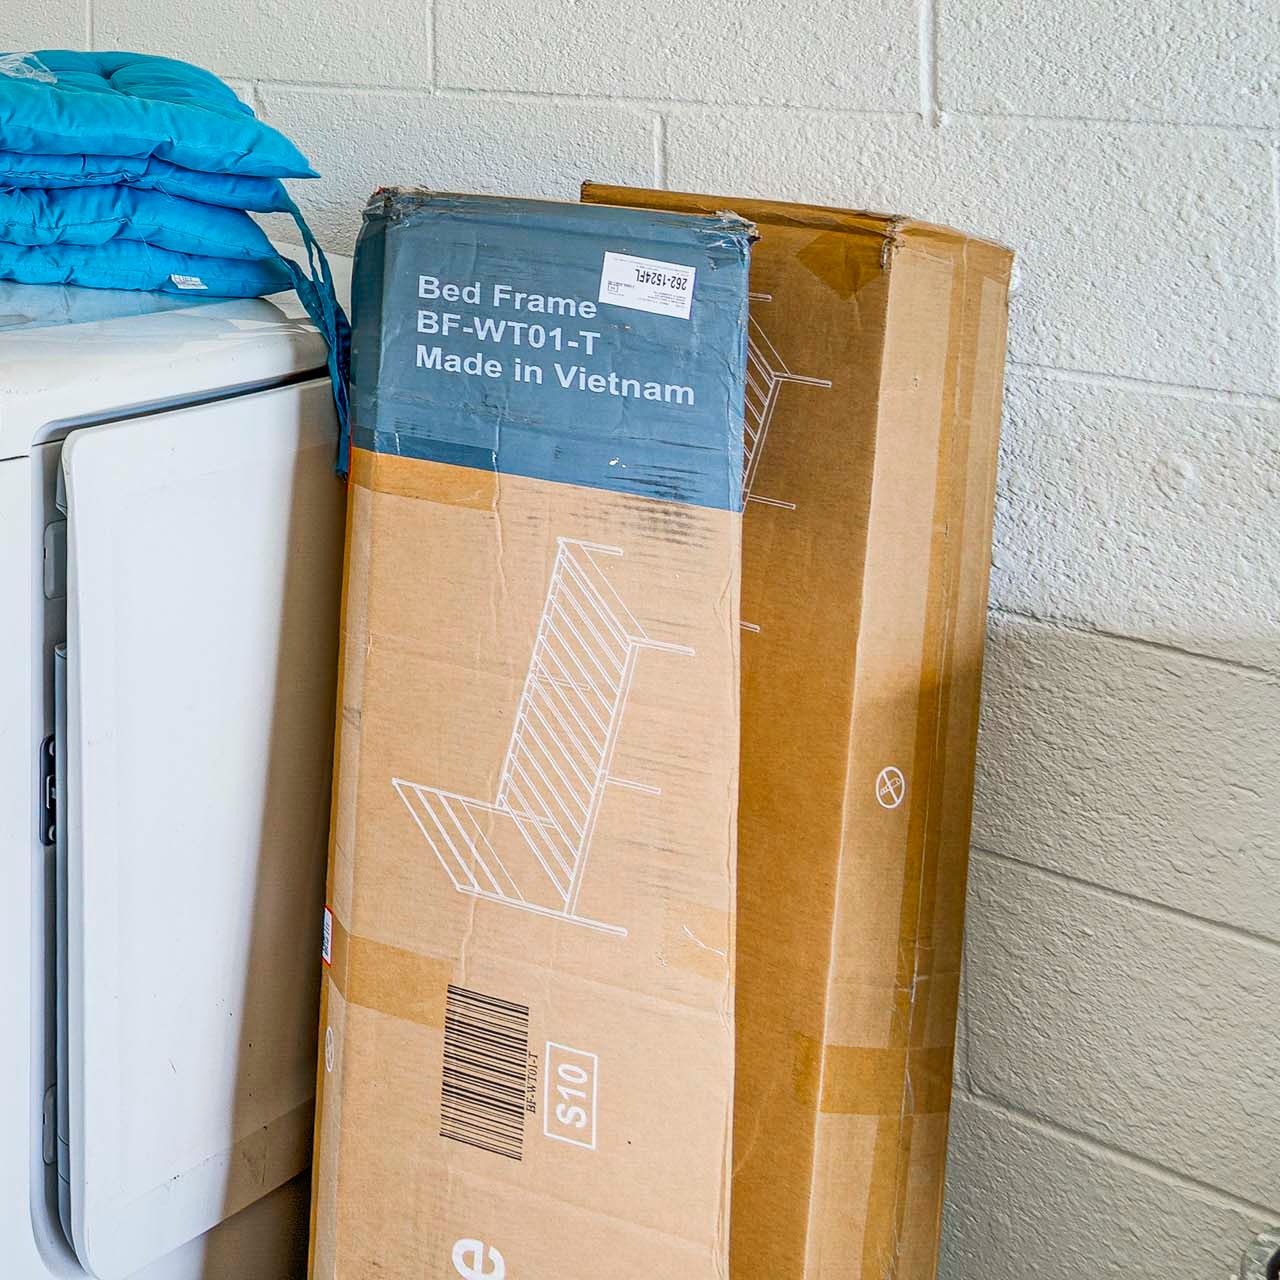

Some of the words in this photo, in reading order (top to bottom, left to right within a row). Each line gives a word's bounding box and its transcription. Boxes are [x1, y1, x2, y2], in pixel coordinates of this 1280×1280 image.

[418, 275, 481, 305] Bed
[493, 284, 598, 319] Frame
[635, 269, 688, 291] 262-1524FL
[416, 310, 601, 356] BF-WT01-T
[415, 344, 503, 378] Made
[514, 358, 543, 385] in
[554, 362, 695, 406] Vietnam
[526, 1051, 539, 1114] BF-WT01-T
[556, 1063, 588, 1128] S10
